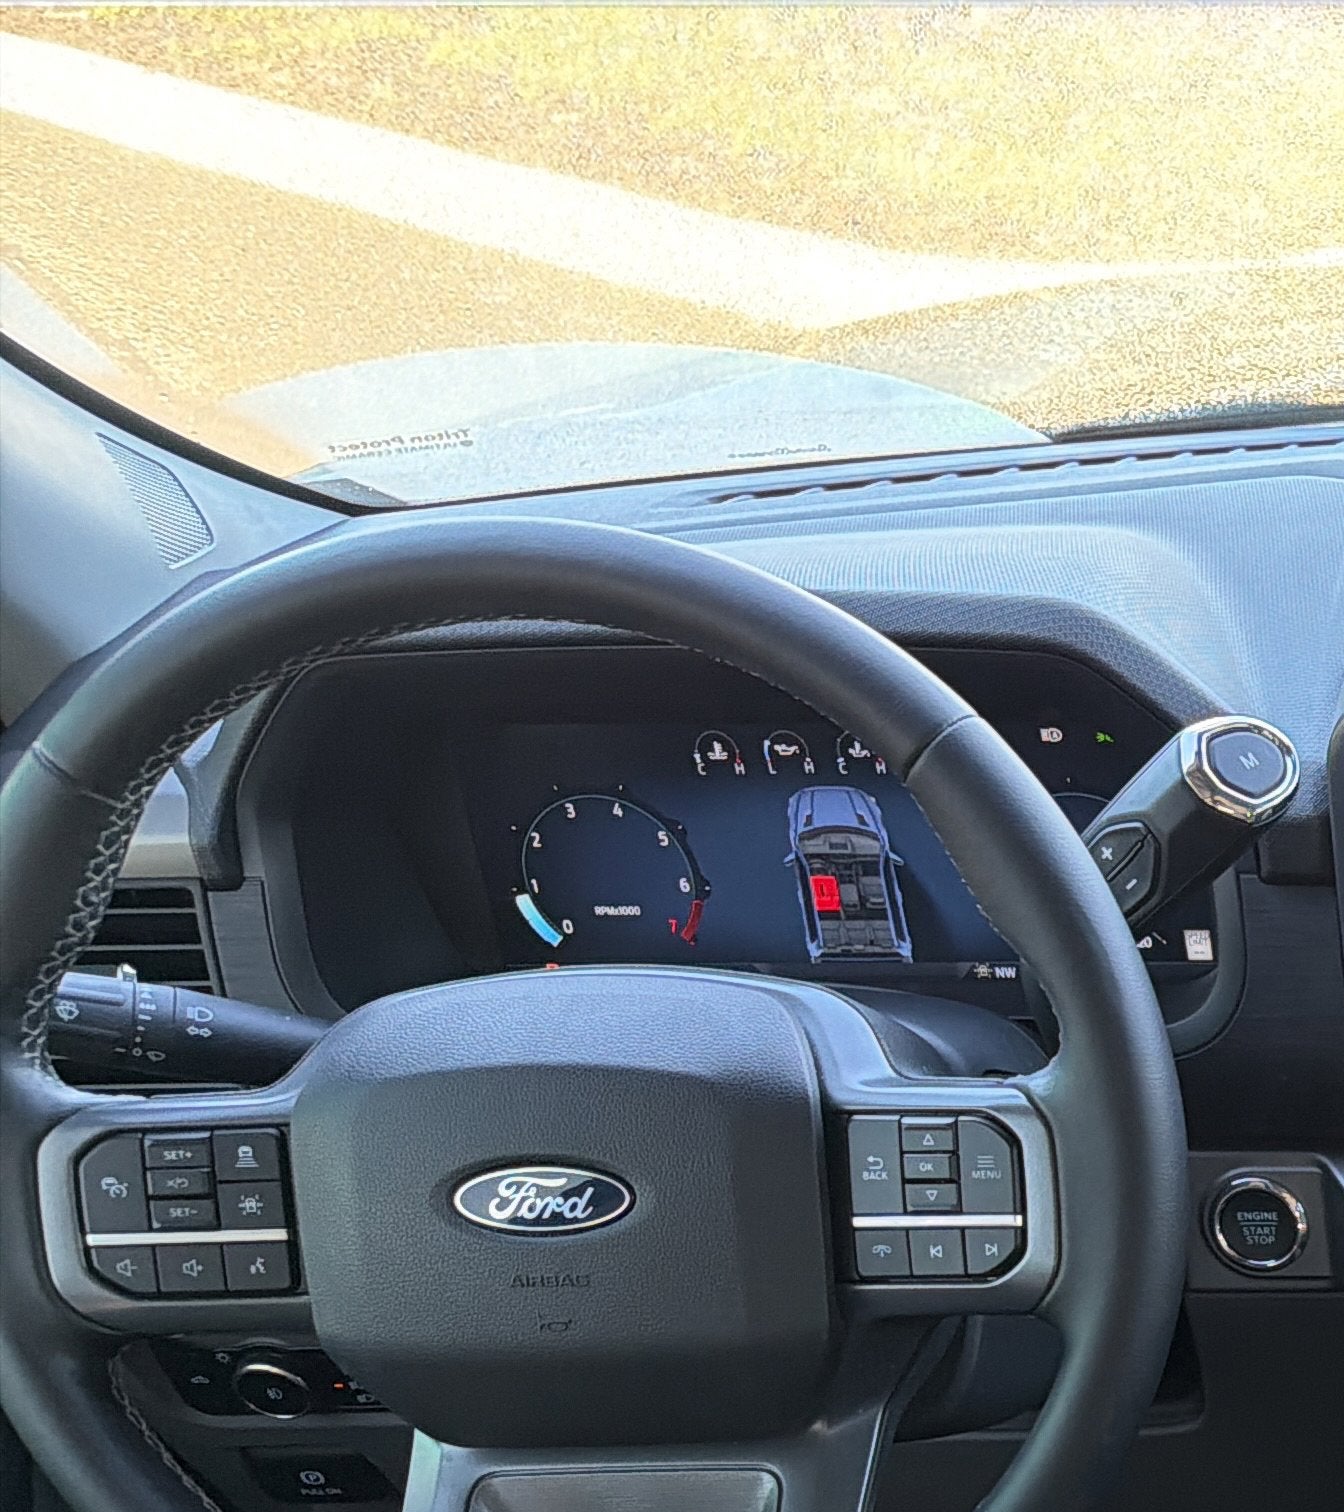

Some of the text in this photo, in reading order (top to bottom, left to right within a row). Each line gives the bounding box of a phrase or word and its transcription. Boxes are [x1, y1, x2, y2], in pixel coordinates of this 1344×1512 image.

[1239, 752, 1260, 769] M
[564, 803, 576, 819] 3
[612, 803, 624, 818] 4
[531, 832, 542, 848] 2
[657, 830, 669, 846] 5
[531, 879, 539, 893] 1
[679, 877, 691, 892] 6
[562, 919, 574, 934] 0
[668, 918, 678, 934] 7
[994, 966, 1016, 979] NW
[919, 1162, 934, 1172] OK
[862, 1170, 888, 1180] BACK
[971, 1170, 1001, 1180] MENU
[488, 1176, 596, 1220] Ford
[1236, 1211, 1278, 1221] ENGINE
[1242, 1226, 1276, 1237] START
[1246, 1236, 1275, 1245] STOP
[510, 1274, 590, 1288] AIRBAG
